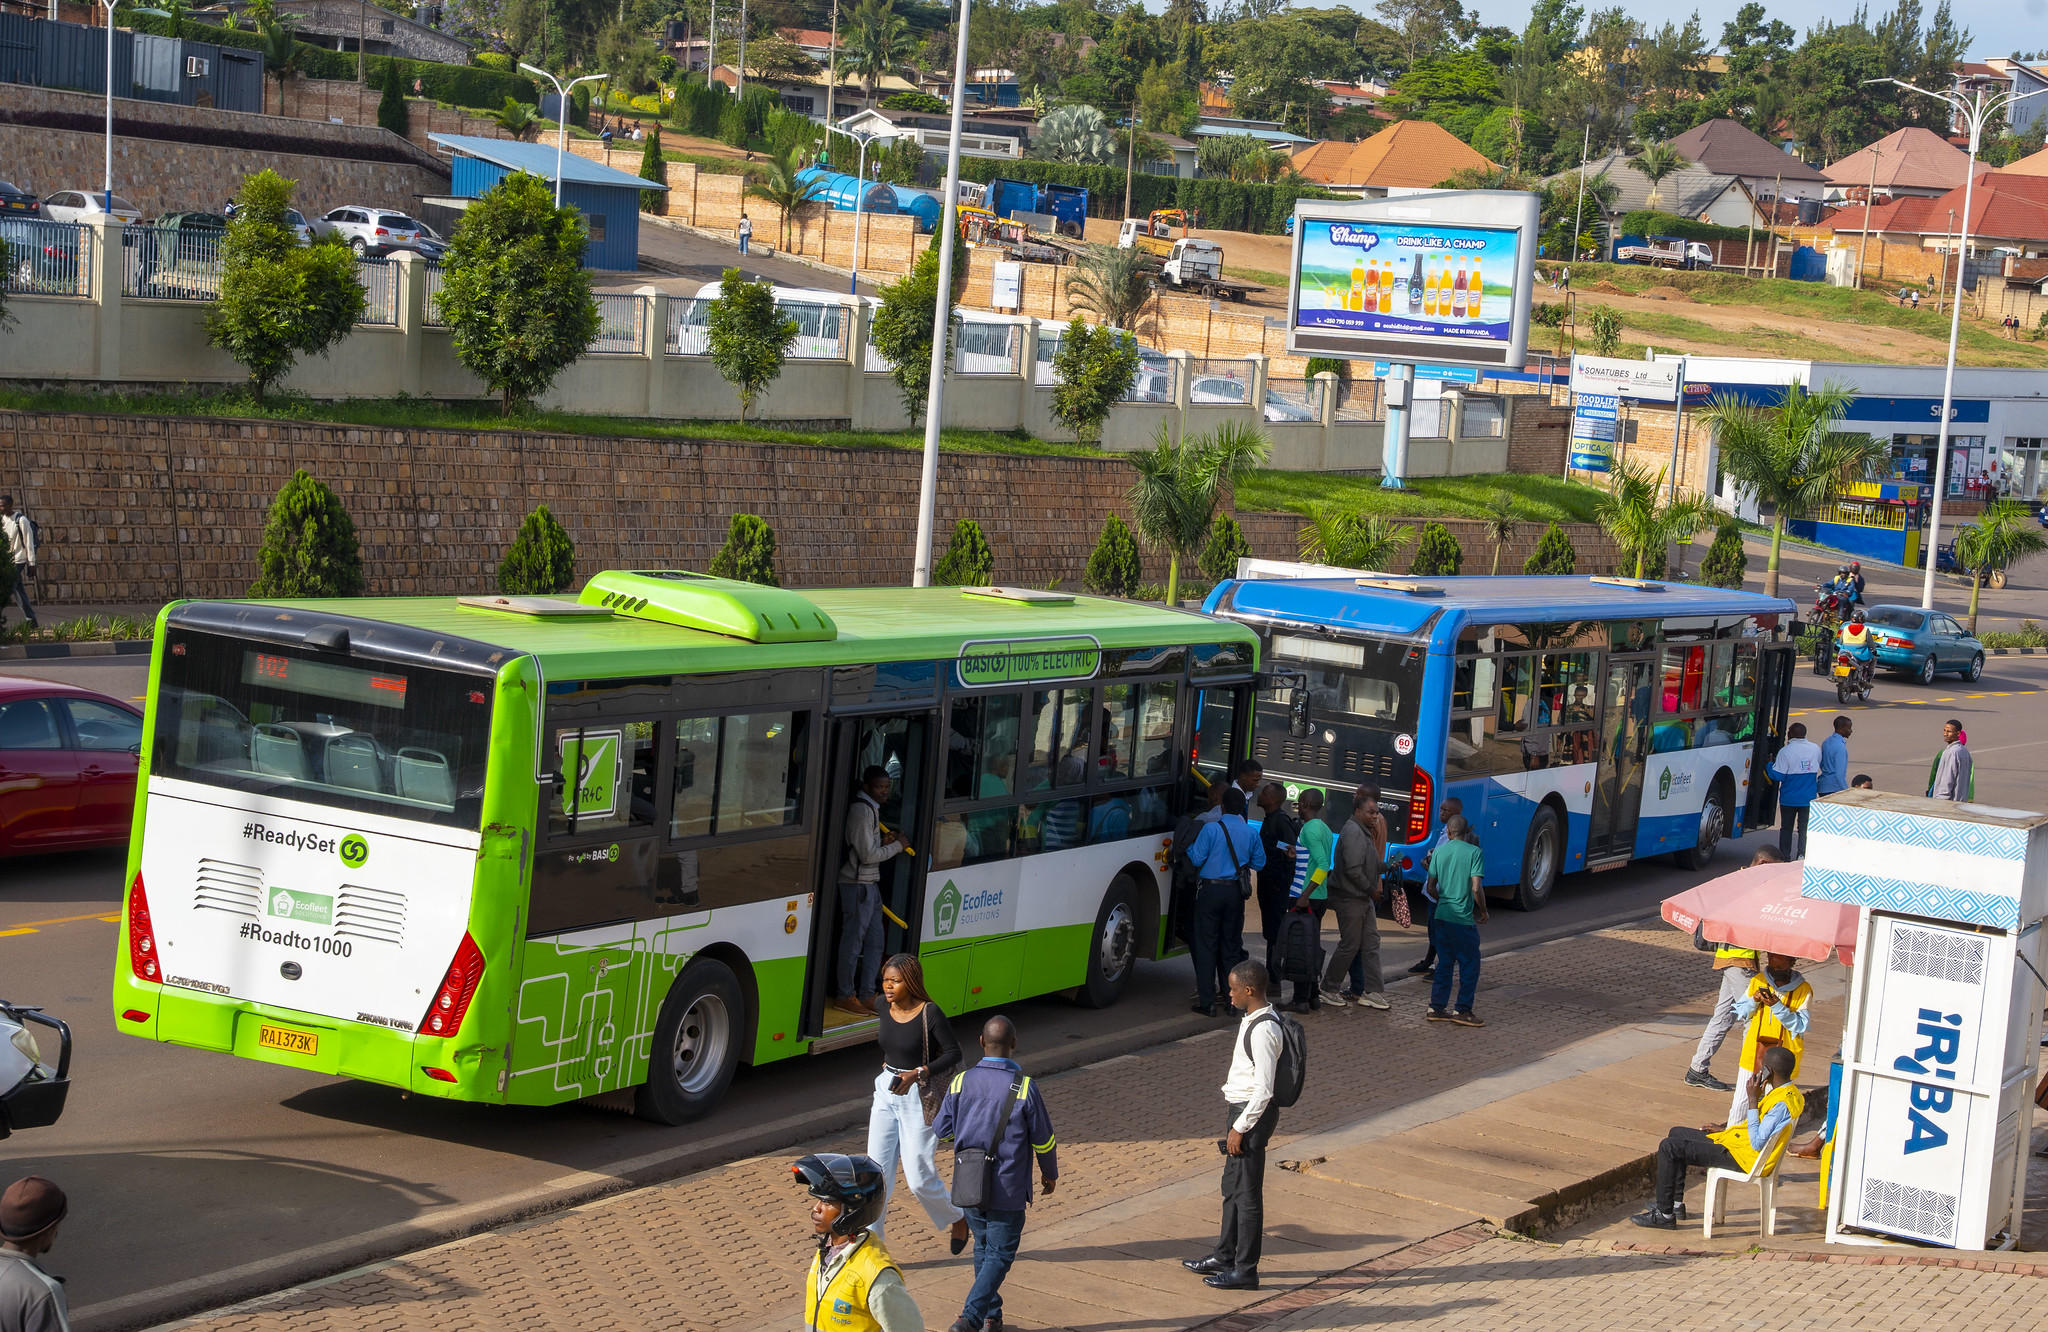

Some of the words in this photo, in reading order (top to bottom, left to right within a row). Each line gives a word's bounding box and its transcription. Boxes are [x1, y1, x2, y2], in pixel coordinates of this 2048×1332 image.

[1330, 225, 1378, 249] Champ
[1397, 236, 1422, 247] DRINK
[1424, 237, 1443, 247] LIKE
[1444, 238, 1452, 248] A
[1453, 238, 1486, 249] CHAMP
[1466, 328, 1489, 336] RWANDA
[1585, 366, 1630, 378] SONATUBES
[1635, 372, 1648, 380] Ltd
[1685, 384, 1709, 393] crave
[1577, 394, 1619, 406] GOODLIFE
[1584, 409, 1614, 418] PHARMACY
[1930, 405, 1958, 420] Shp
[1574, 442, 1601, 452] OPTICA
[257, 654, 289, 678] 102
[1013, 653, 1040, 673] 100%
[1043, 651, 1092, 671] ELECTRIC
[1398, 738, 1410, 747] 60
[243, 822, 336, 854] #ReadySet
[295, 900, 328, 914] Ecofleet
[962, 889, 1003, 911] Ecofleet
[294, 910, 327, 920] SOLUTIONS
[961, 908, 1000, 925] SOLUTIONS
[1761, 903, 1809, 919] airtel
[1759, 914, 1797, 926] money
[240, 922, 352, 958] #Roadto1000
[356, 1011, 389, 1027] ZHONG
[389, 1017, 414, 1031] TONG
[830, 1315, 852, 1325] MoMo
